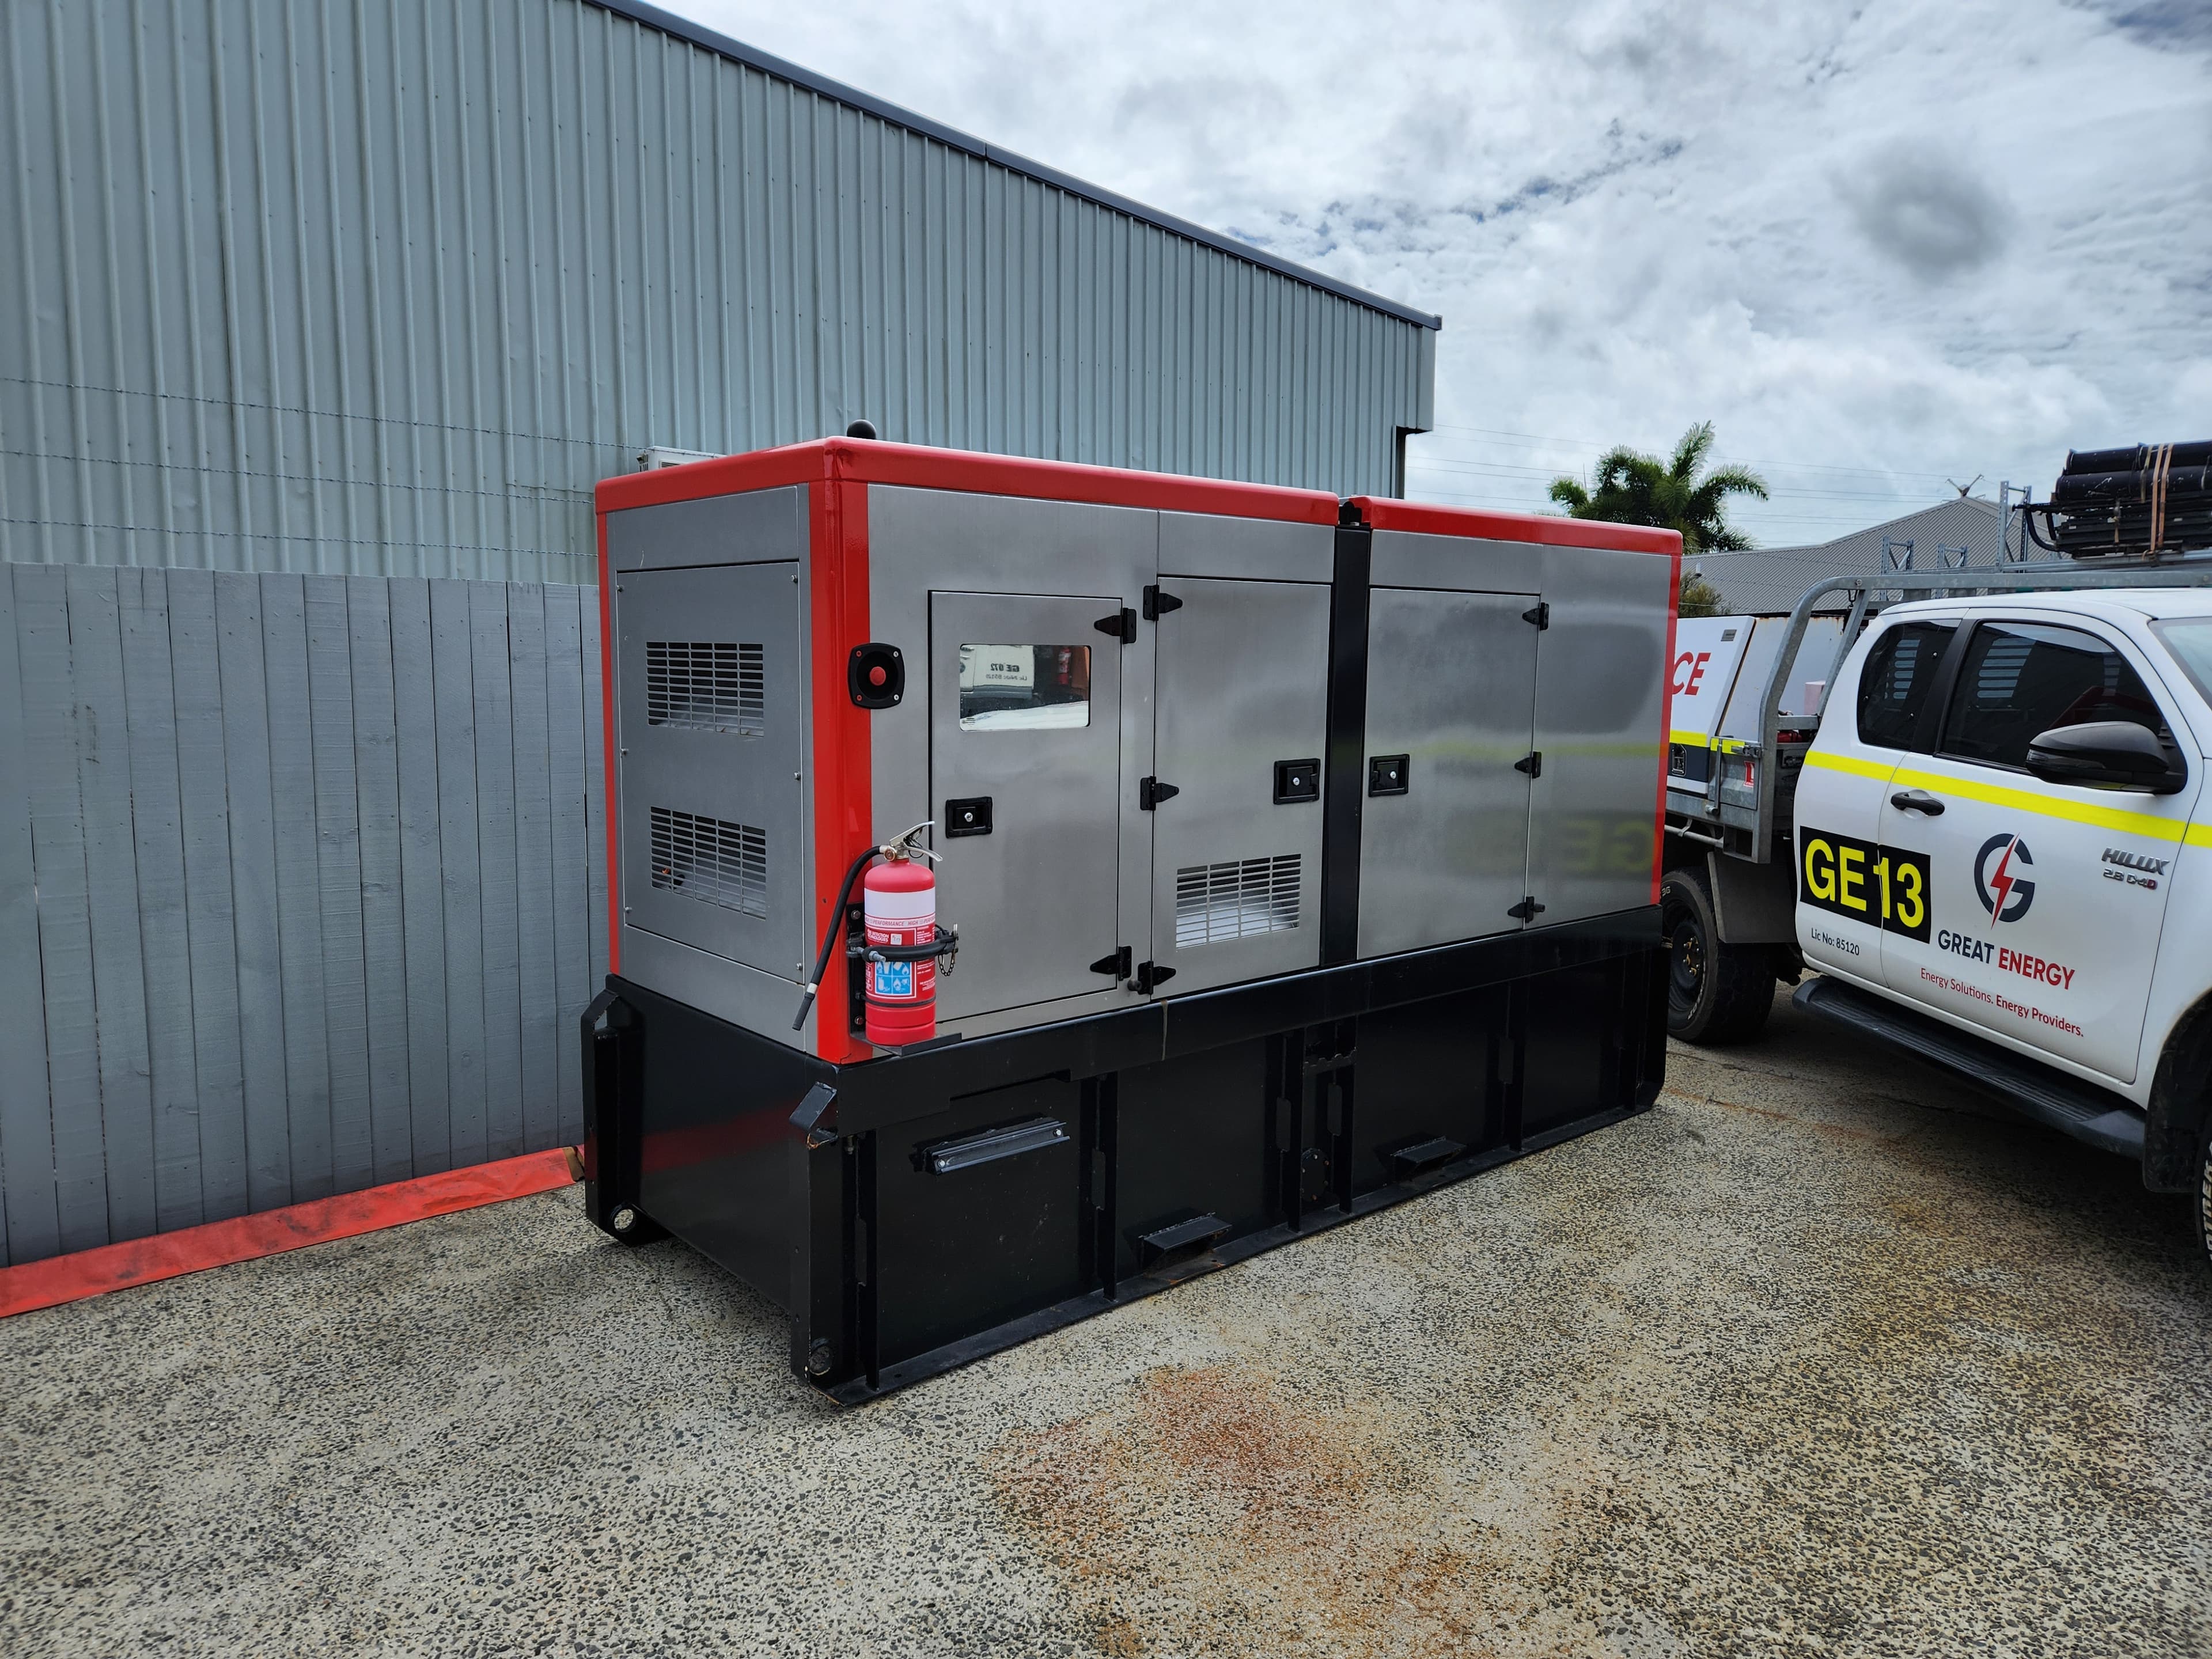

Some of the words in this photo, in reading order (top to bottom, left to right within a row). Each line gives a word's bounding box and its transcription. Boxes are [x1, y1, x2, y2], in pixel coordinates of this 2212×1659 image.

[2101, 847, 2171, 876] HILUX
[2103, 868, 2124, 881] 2.8
[1812, 927, 1820, 941] Lic
[1823, 932, 1835, 946] No:
[1836, 938, 1859, 956] 85120
[1938, 929, 1994, 964] GREAT
[1998, 947, 2075, 990] ENERGY
[1921, 968, 1948, 989] Energy
[1950, 978, 1994, 1004] Solutions.
[1997, 994, 2029, 1018] Energy
[2032, 1007, 2084, 1037] Providers.
